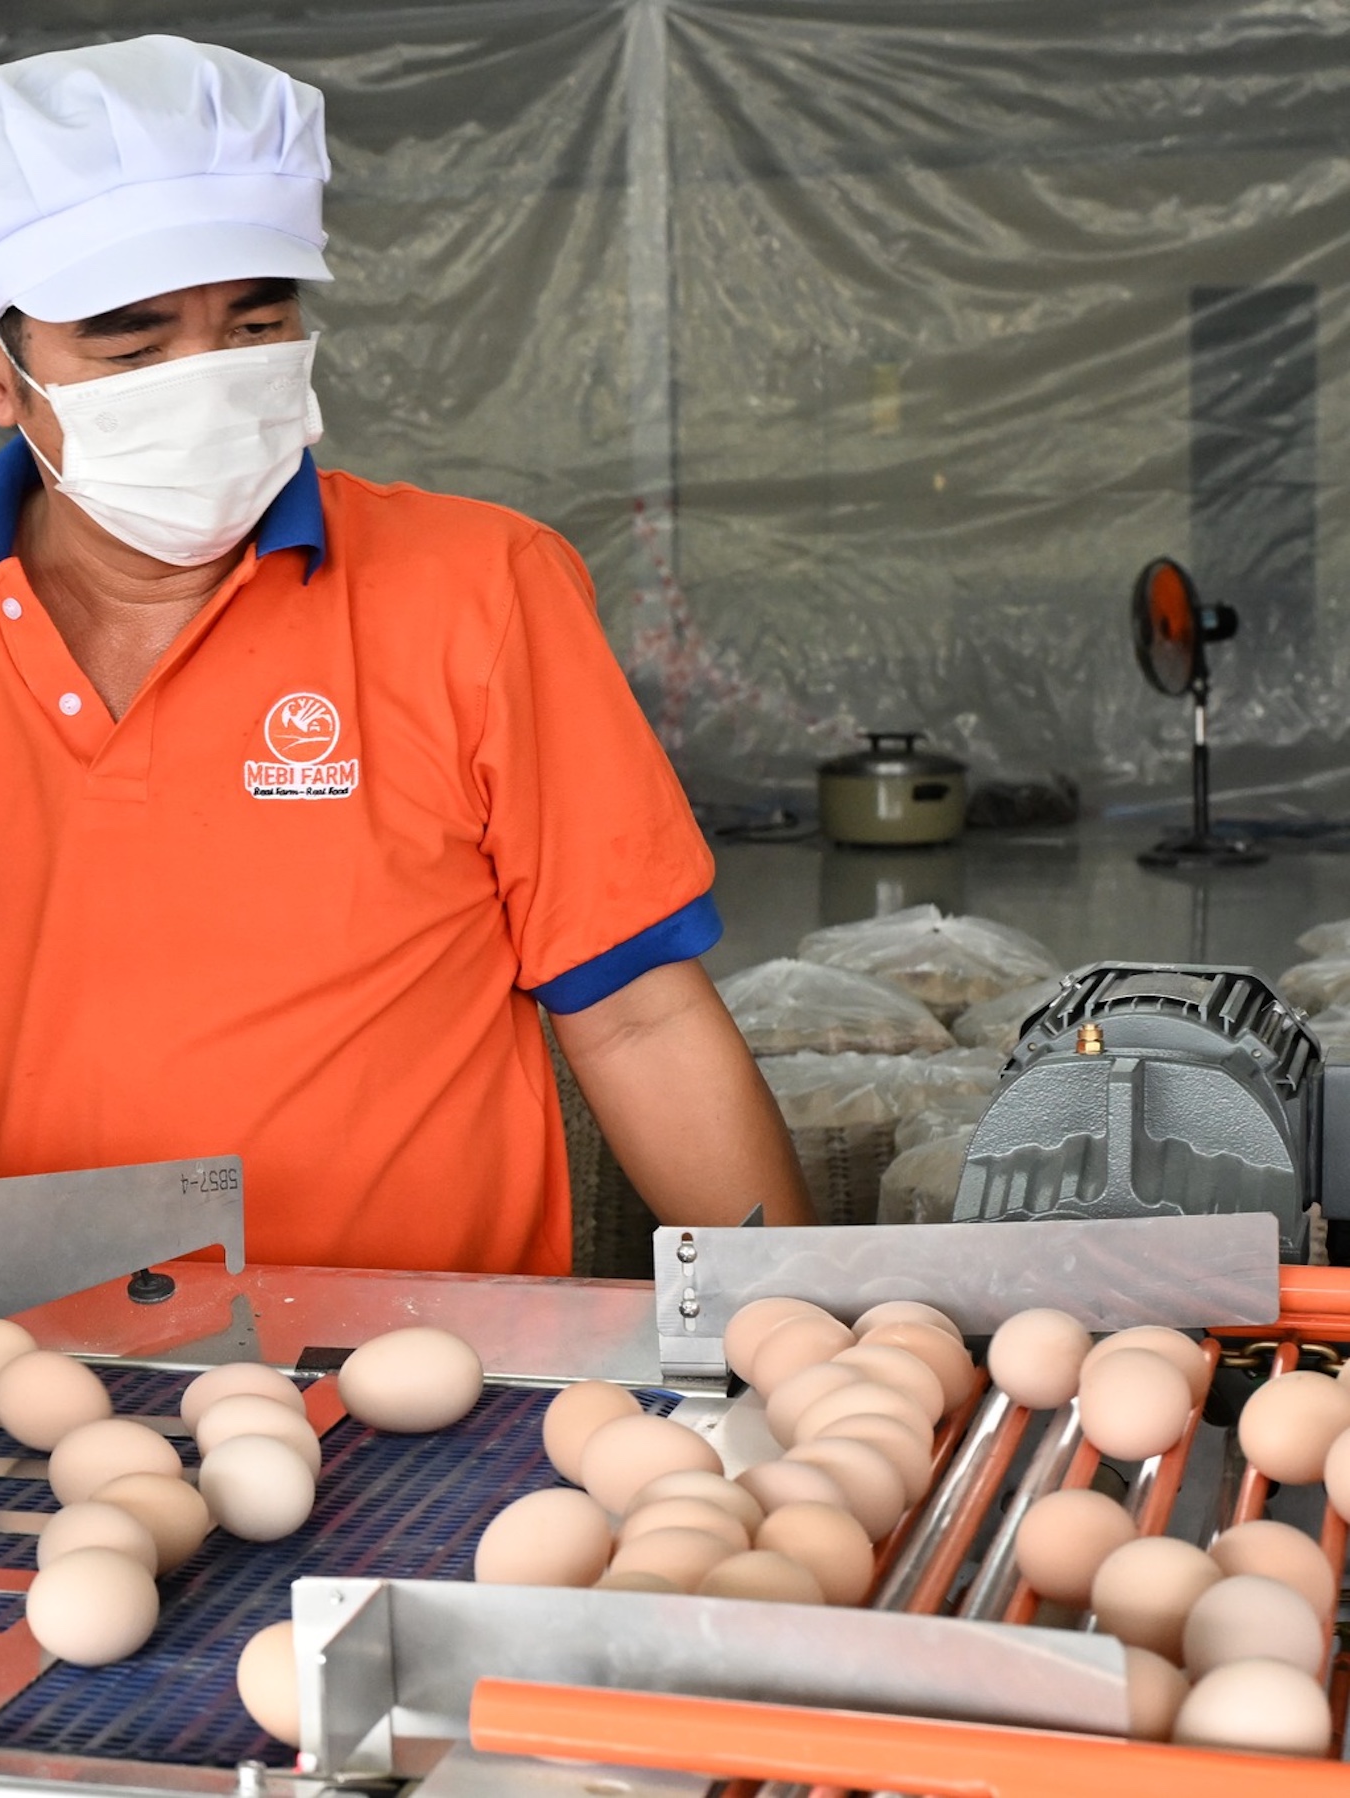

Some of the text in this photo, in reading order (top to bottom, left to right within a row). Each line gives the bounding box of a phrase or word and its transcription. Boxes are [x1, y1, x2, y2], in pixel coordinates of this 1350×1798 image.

[247, 761, 355, 788] MEBI FARM
[253, 786, 274, 796] Real
[306, 786, 326, 796] Real
[328, 786, 349, 796] Food
